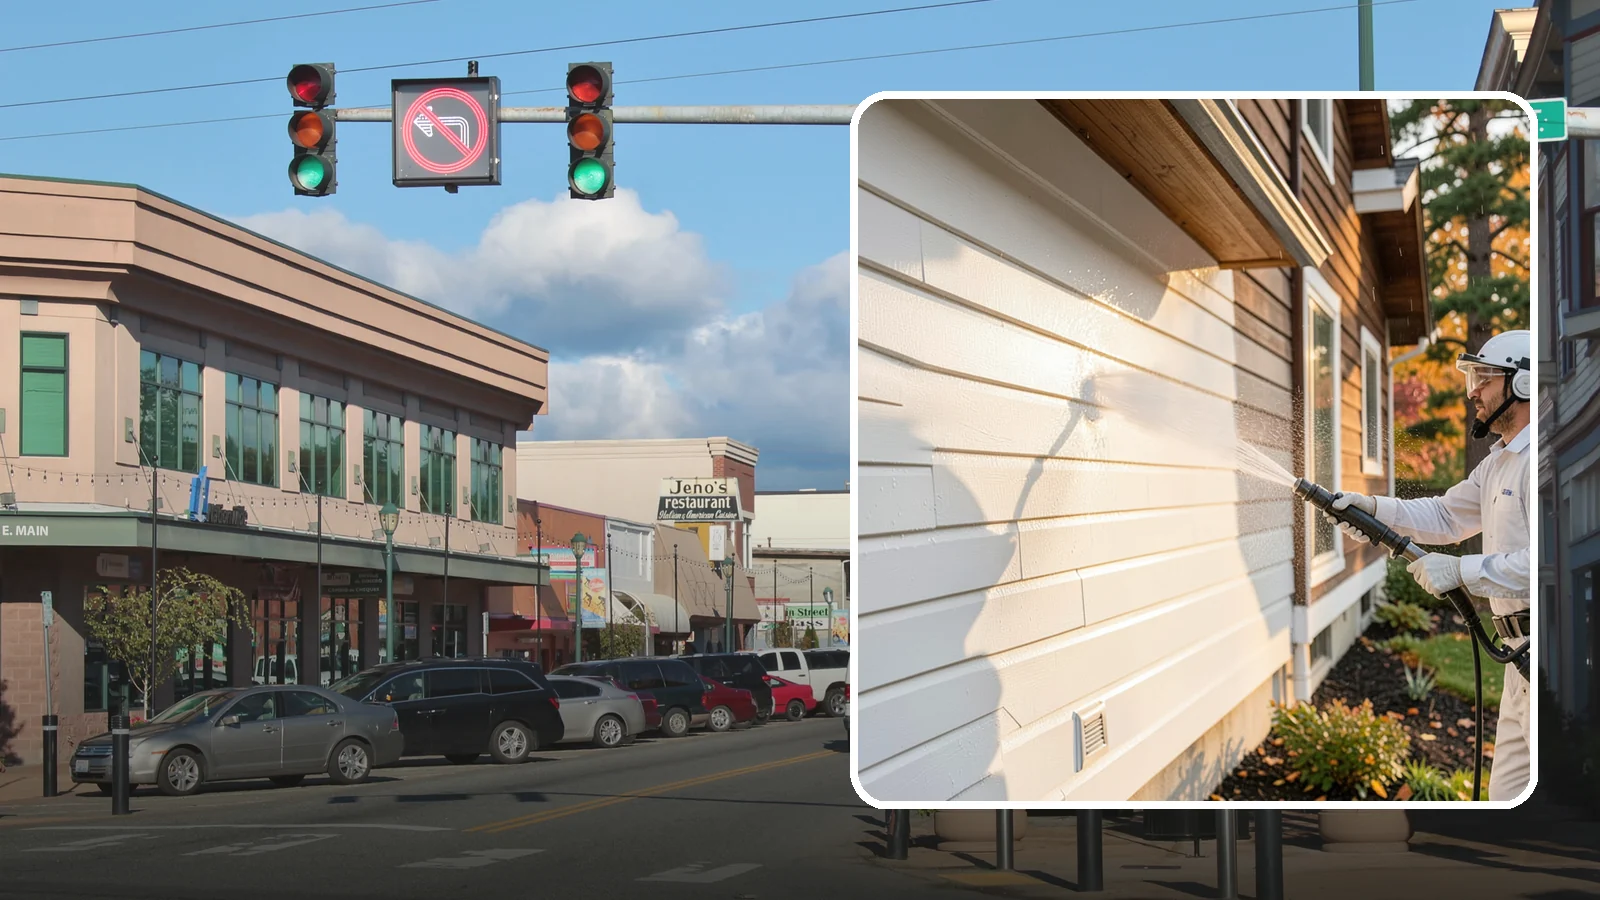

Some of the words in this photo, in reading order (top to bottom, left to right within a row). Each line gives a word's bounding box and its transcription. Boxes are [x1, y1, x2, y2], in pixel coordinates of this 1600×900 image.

[669, 479, 728, 495] Jeno's
[664, 496, 731, 509] restaurant
[658, 509, 682, 520] Italian
[686, 509, 715, 520] American
[715, 509, 737, 519] Cuisine
[2, 525, 13, 536] E.
[15, 525, 49, 536] MAIN
[797, 607, 828, 617] Street
